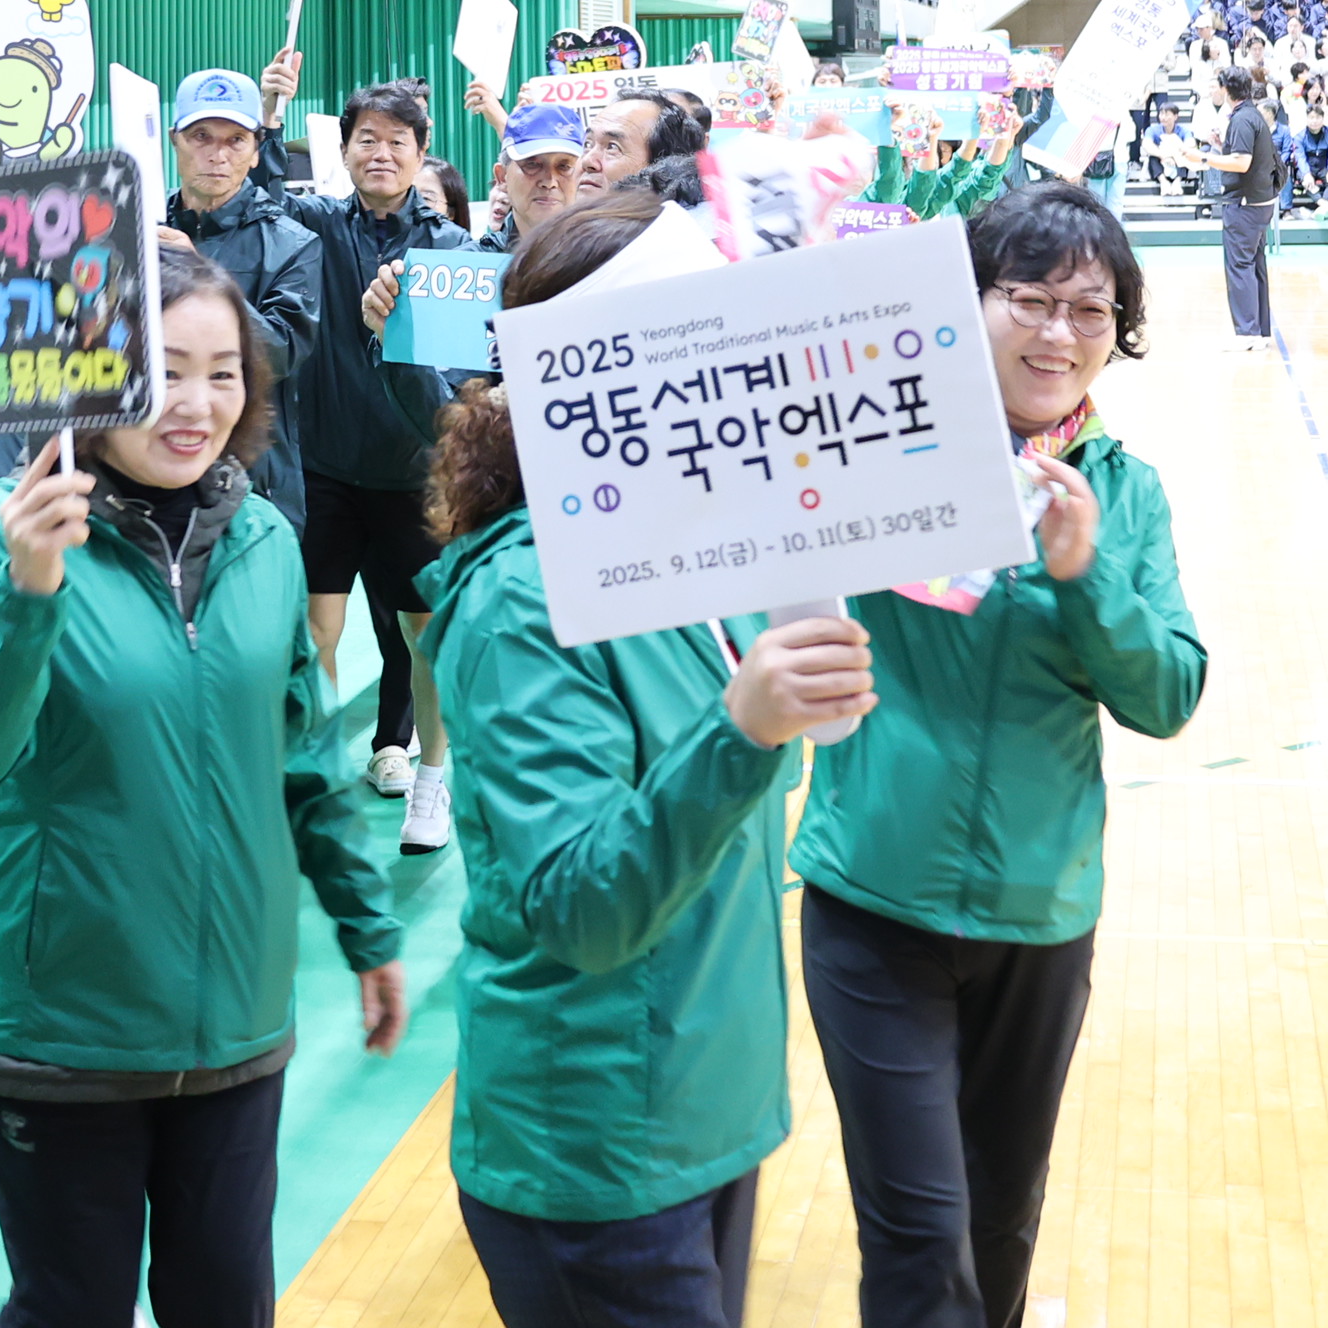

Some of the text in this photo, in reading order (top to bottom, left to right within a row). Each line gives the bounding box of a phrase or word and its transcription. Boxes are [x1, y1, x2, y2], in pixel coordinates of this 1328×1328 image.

[1110, 22, 1147, 49] 엑스포
[1112, 5, 1165, 40] 세계국악
[892, 60, 921, 74] 2025
[916, 73, 984, 90] 성공기원
[540, 79, 609, 103] 2025
[408, 265, 497, 302] 2025
[537, 334, 635, 383] 2025
[640, 315, 724, 342] Yeongdong
[645, 300, 912, 366] World Traditional Music & Arts Expo
[544, 353, 790, 467] 영동세계
[666, 375, 934, 492] 국악엑스포
[599, 559, 661, 589] 2025.
[882, 503, 958, 539] 30일간
